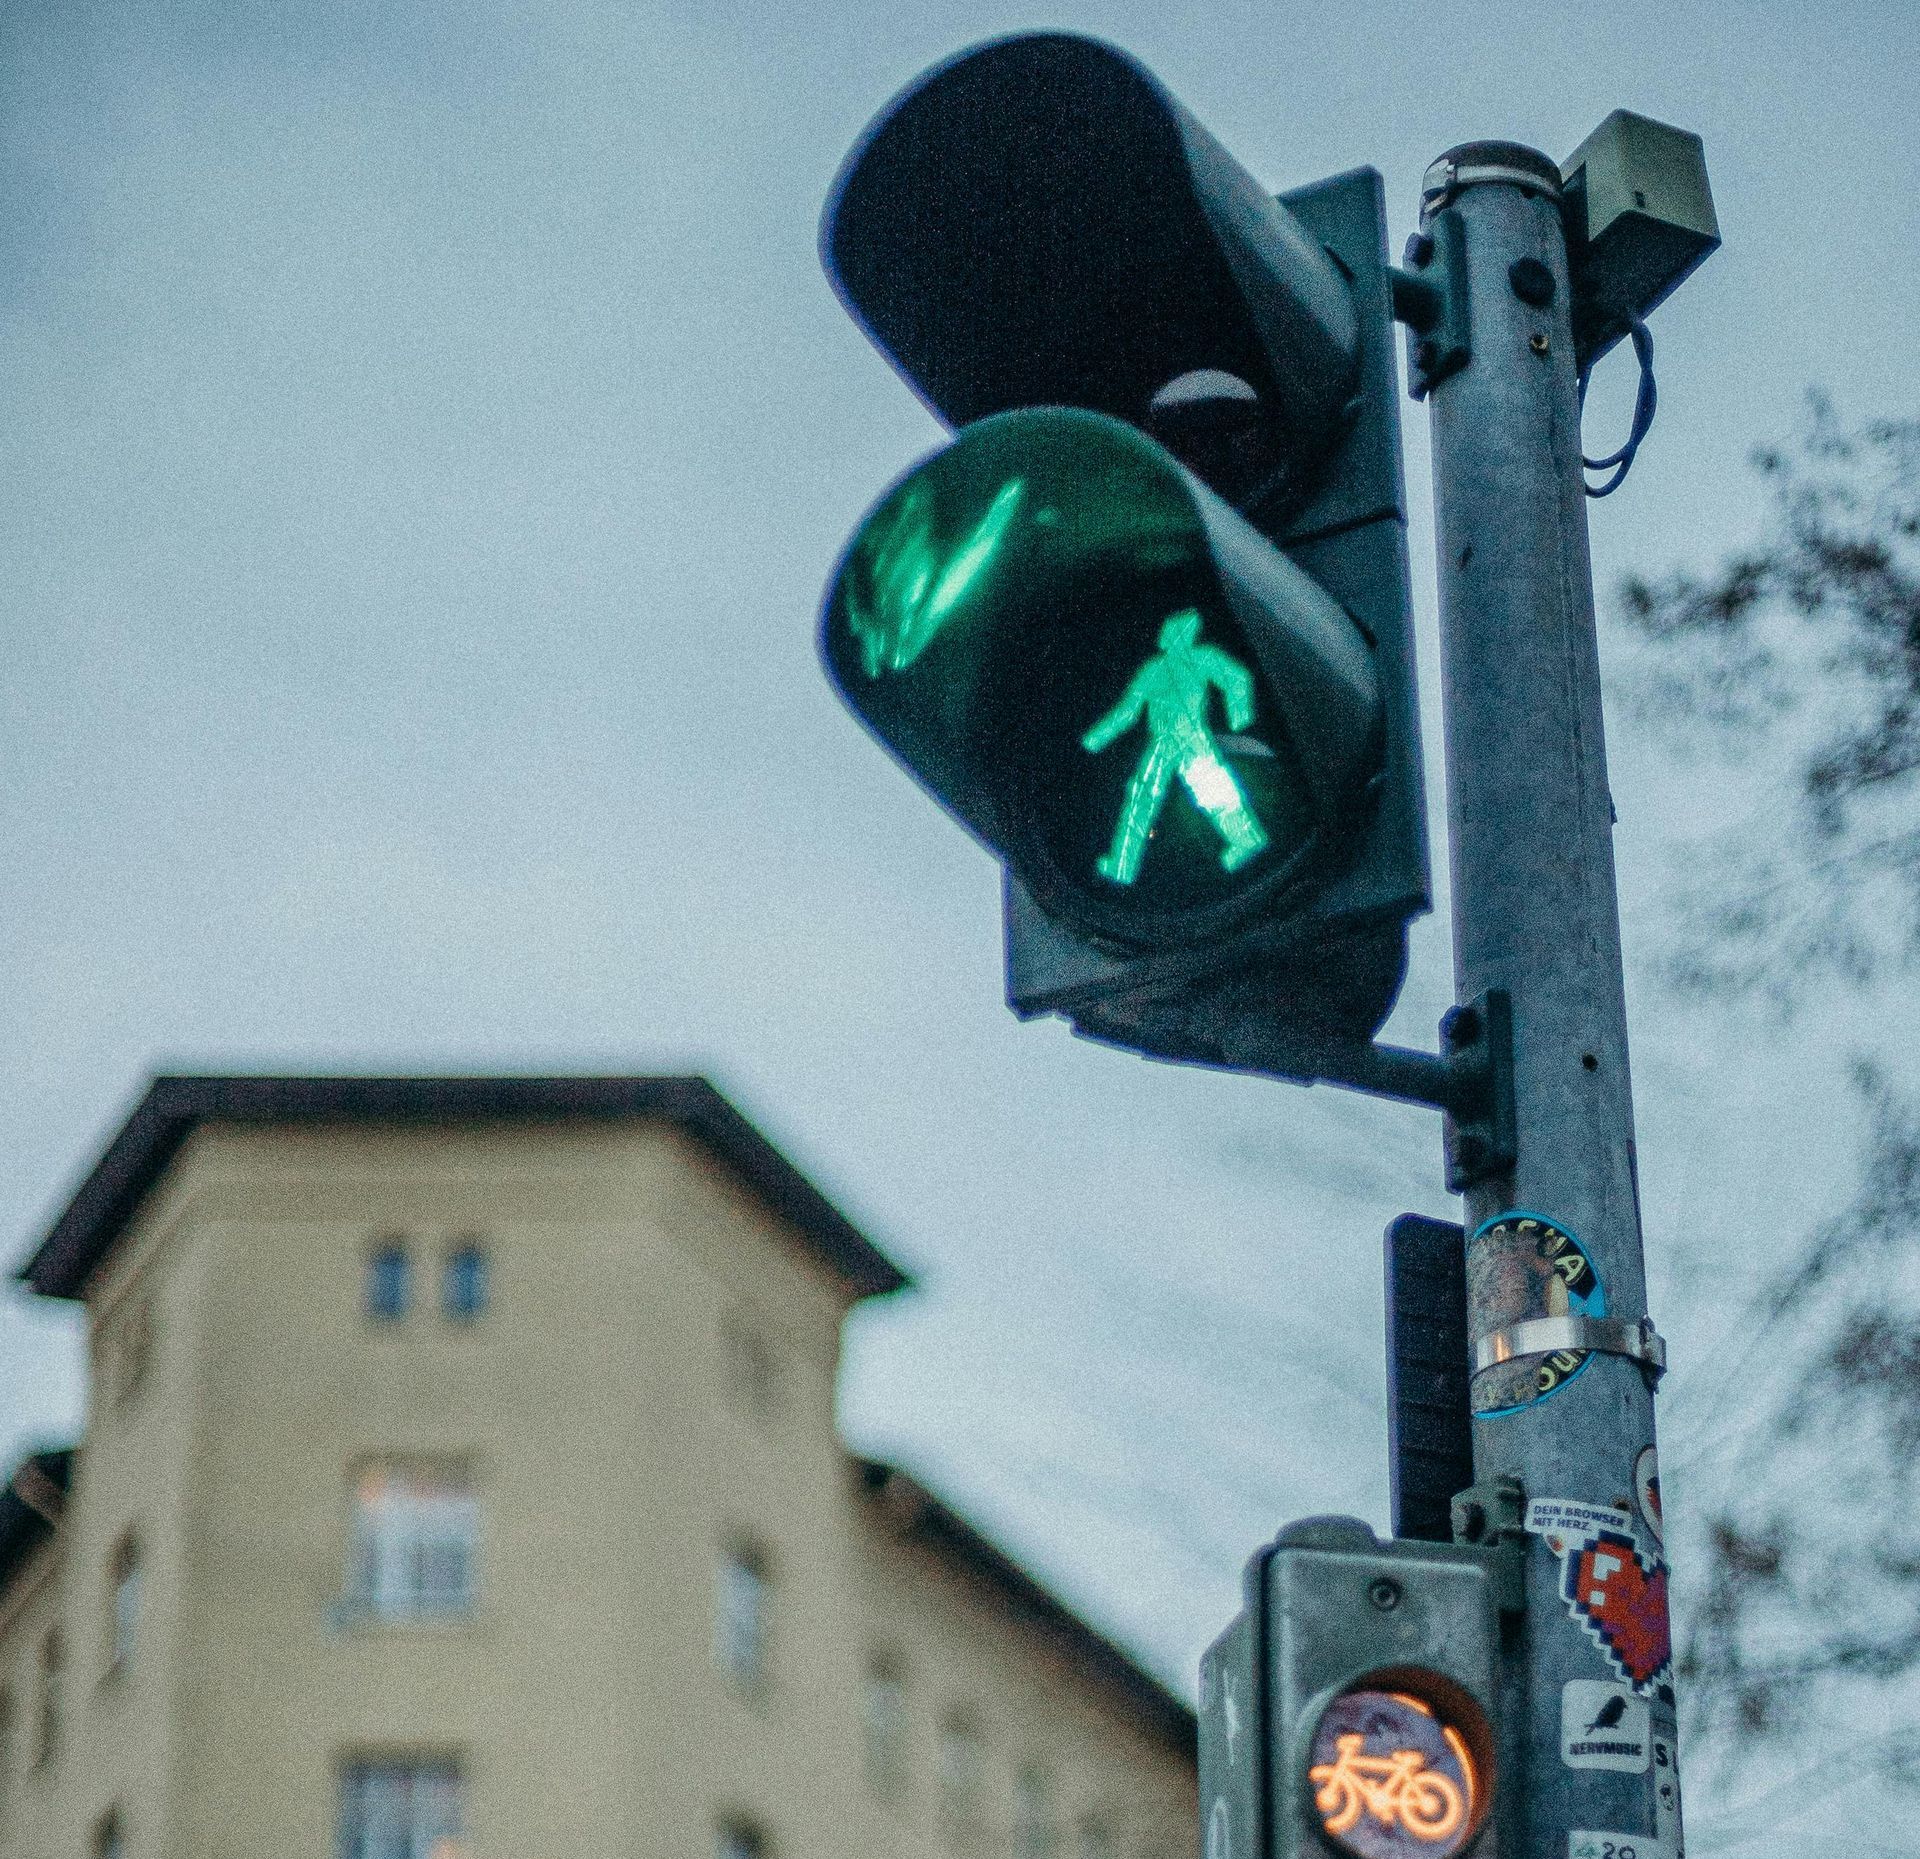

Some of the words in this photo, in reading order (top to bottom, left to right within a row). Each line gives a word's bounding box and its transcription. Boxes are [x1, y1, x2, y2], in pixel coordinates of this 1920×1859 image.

[1532, 1517, 1554, 1527] MIT
[1533, 1505, 1562, 1515] DEIN
[1565, 1507, 1625, 1527] BROWSER
